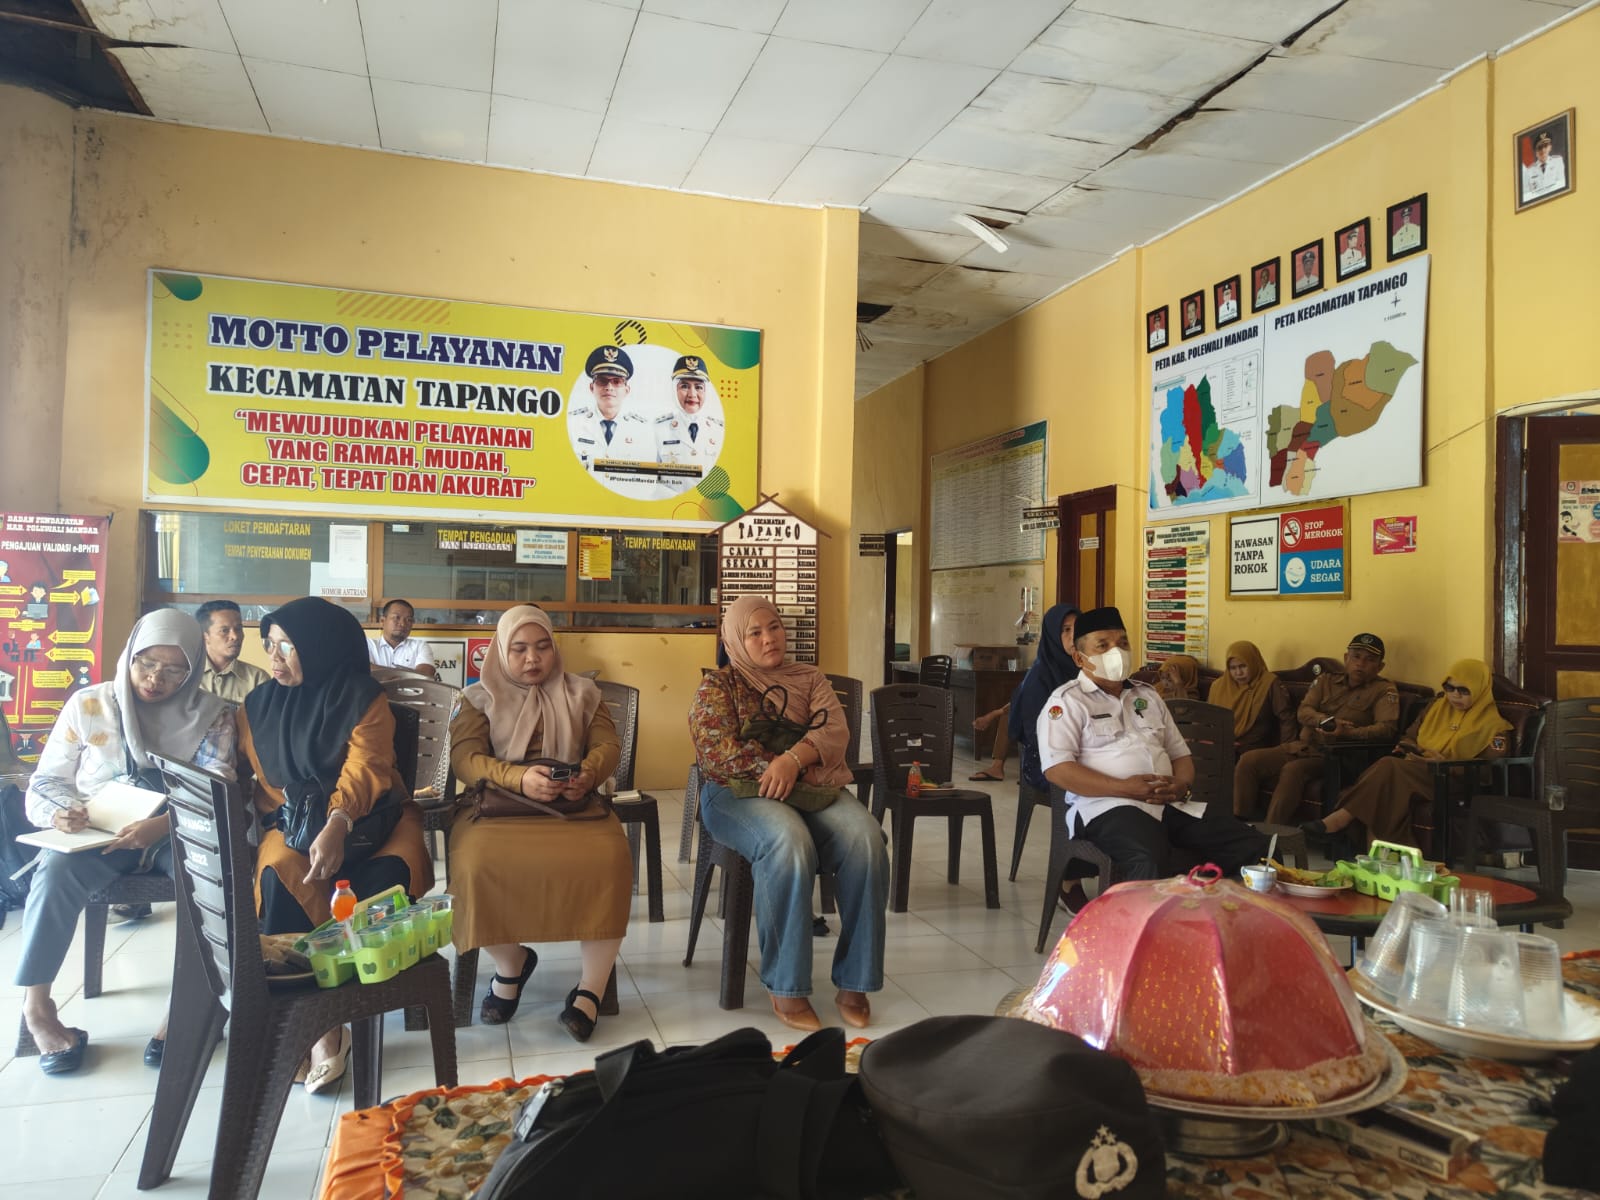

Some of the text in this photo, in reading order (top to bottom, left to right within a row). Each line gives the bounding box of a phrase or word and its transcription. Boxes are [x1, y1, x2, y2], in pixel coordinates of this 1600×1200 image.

[1274, 272, 1408, 330] PETA KECAMATAN TAPANGO
[210, 315, 562, 372] MOTTO PELAYANAN
[1155, 325, 1258, 371] PETA KAB. POLEWALI MANDAR
[209, 364, 561, 415] KECAMATAN TAPANGO
[236, 411, 532, 448] “MEWUJUDKAN PELAYANAN
[267, 438, 509, 473] YANG RAMAH, MUDAH,
[242, 464, 536, 498] CEPAT, TEPAT DAN AKURAT”
[223, 521, 311, 536] LOKET PENDAFTARAN
[739, 522, 800, 540] TAPANGO
[1304, 520, 1324, 530] STOP
[438, 529, 516, 544] TEMPAT PENGADUAN
[1304, 528, 1344, 540] MEROKOK
[1, 541, 41, 552] PENGAJUAN
[42, 542, 71, 553] VALIDASI
[624, 536, 696, 550] TEMPAT PEMBAYARAN
[1234, 536, 1274, 549] KAWASAN
[729, 547, 763, 556] CAMAT
[1234, 549, 1264, 562] TANPA
[726, 559, 768, 568] SEKCAM
[1234, 562, 1268, 575] ROKOK
[1310, 558, 1342, 570] UDARA
[1310, 572, 1341, 583] SEGAR
[434, 659, 457, 669] SAN
